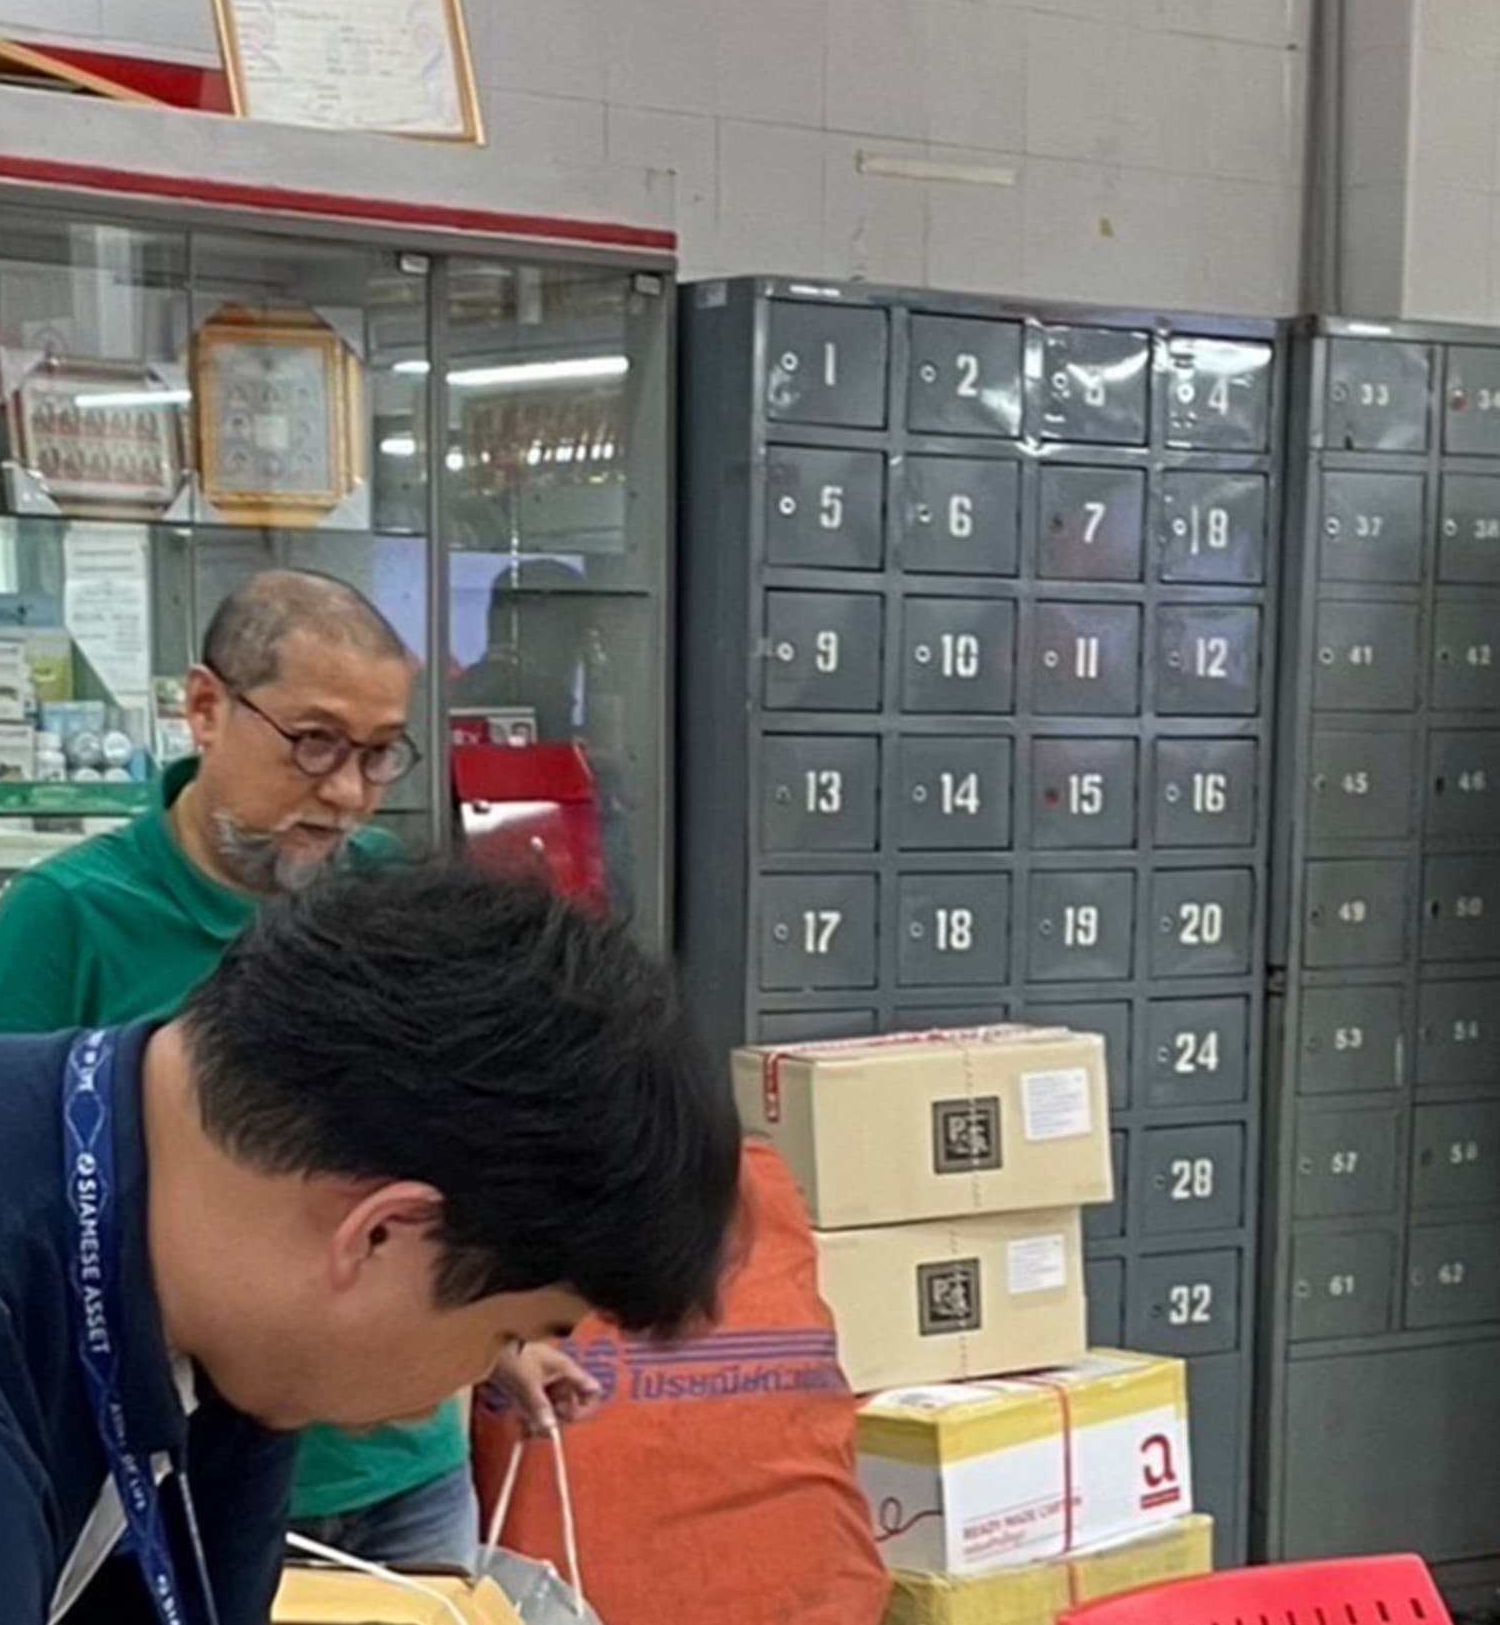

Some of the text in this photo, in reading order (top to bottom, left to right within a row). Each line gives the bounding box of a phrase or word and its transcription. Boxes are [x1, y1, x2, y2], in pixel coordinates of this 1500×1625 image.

[825, 343, 836, 385] 1
[957, 355, 978, 397] 2
[1208, 383, 1229, 415] 4
[1361, 385, 1388, 406] 33
[820, 486, 1227, 547] 5 6 7 8
[1357, 516, 1381, 536] 37
[1474, 520, 1499, 538] 38
[816, 631, 1227, 677] 9 10 11 12
[1349, 647, 1372, 664] 41
[1467, 647, 1491, 665] 42
[807, 771, 1224, 814] 13 14 15 16
[1343, 775, 1368, 793] 45
[803, 904, 1221, 953] 17 18 19 20
[1340, 898, 1482, 922] 49 50
[1175, 1033, 1218, 1071] 24
[1335, 1030, 1362, 1048] 53
[1171, 1159, 1213, 1198] 28
[1332, 1153, 1358, 1171] 57
[76, 1178, 110, 1354] SIAMESE ASSET
[1330, 1276, 1354, 1294] 61
[1169, 1285, 1211, 1323] 32
